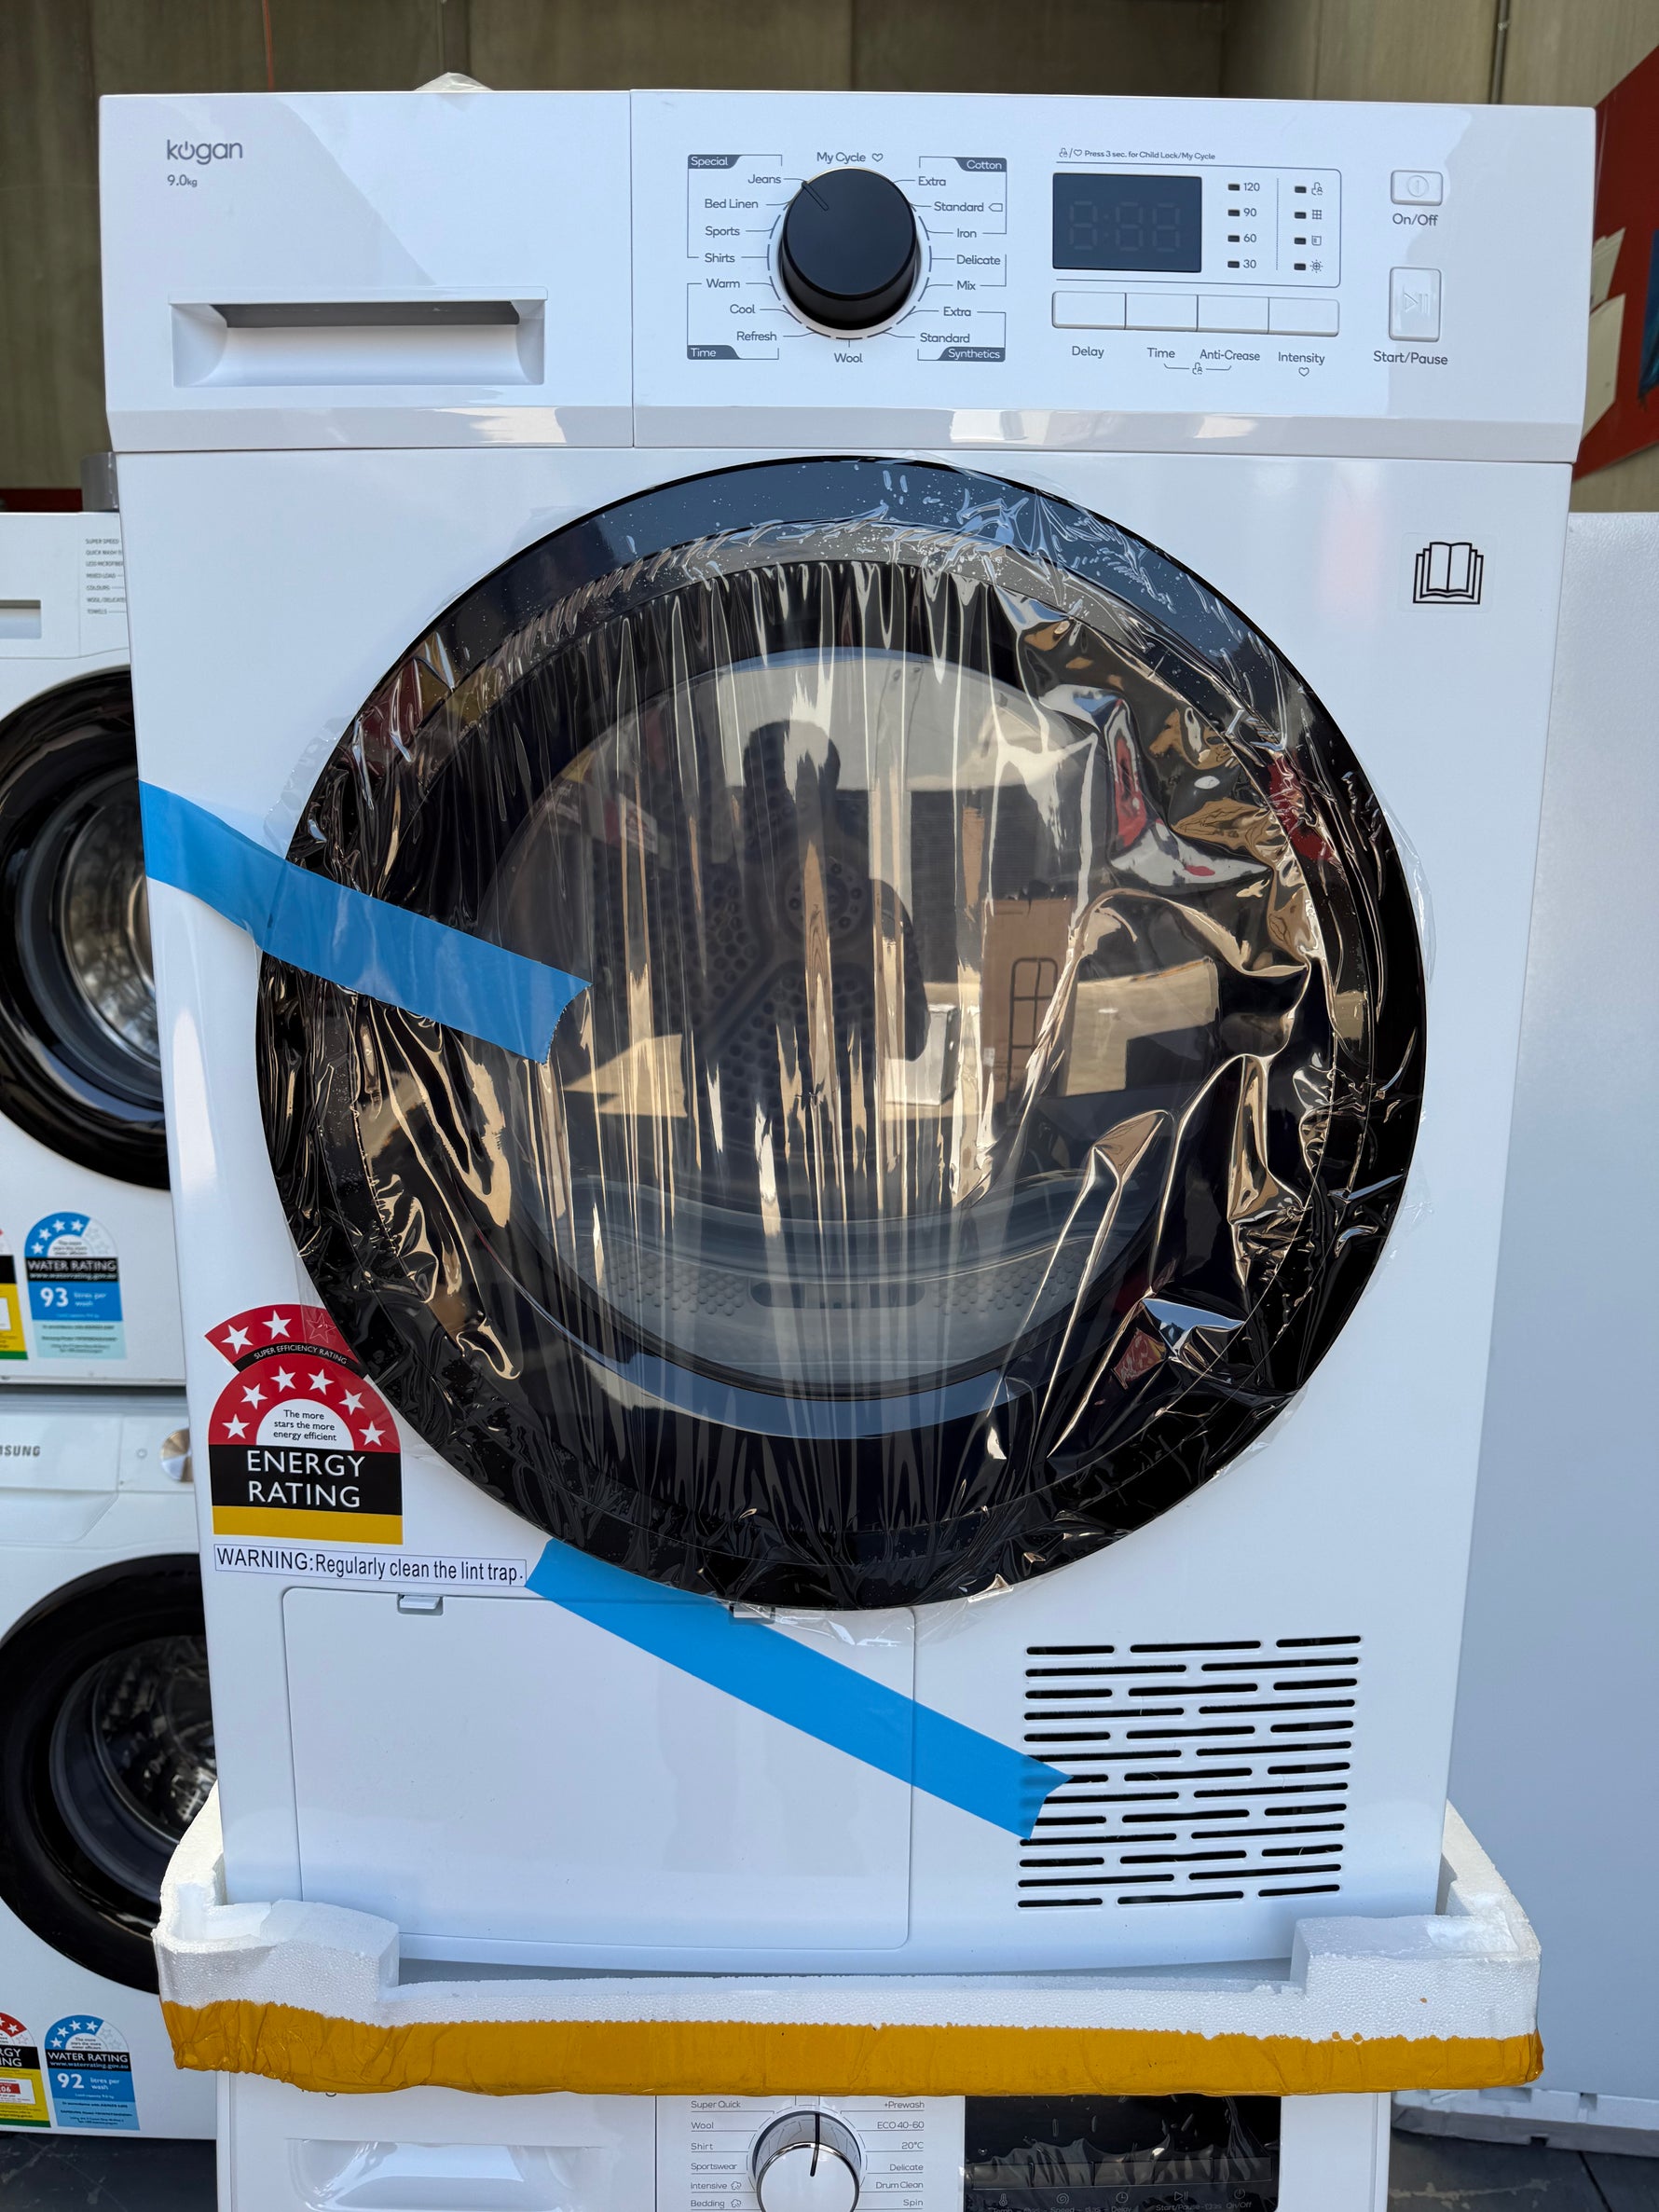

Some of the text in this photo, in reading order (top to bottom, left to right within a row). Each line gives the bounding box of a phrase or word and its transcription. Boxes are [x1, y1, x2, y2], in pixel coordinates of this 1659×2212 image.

[167, 139, 243, 165] kogan
[1128, 150, 1139, 158] for
[1139, 150, 1159, 158] Child
[1160, 151, 1193, 161] Lock/My
[1194, 152, 1215, 161] Cycle
[691, 156, 729, 169] Special
[816, 152, 866, 164] My Cycle
[967, 159, 1003, 171] Cotton
[167, 173, 198, 188] 9.0kg
[748, 174, 782, 185] Jeans
[918, 176, 947, 187] Extra
[1243, 182, 1260, 192] 120
[705, 199, 759, 209] Bed Linen
[934, 201, 984, 213] Standard
[1243, 208, 1257, 217] 90
[1392, 213, 1439, 227] On/Off
[705, 226, 740, 239] Sports
[956, 228, 977, 239] Iron
[1243, 233, 1257, 243] 60
[705, 253, 735, 263] Shirts
[956, 254, 1001, 266] Delicate
[1243, 259, 1256, 269] 30
[706, 279, 741, 289] Warm
[956, 281, 977, 291] Mix
[730, 304, 756, 314] Cool
[943, 306, 972, 317] Extra
[736, 331, 777, 341] Refresh
[920, 333, 970, 344] Standard
[690, 347, 717, 358] Time
[834, 352, 863, 364] Wool
[948, 348, 1001, 361] Synthetics
[1071, 346, 1104, 360] Delay
[1146, 347, 1175, 359] Time
[1200, 349, 1261, 362] Anti-Crease
[1278, 350, 1325, 365] Intensity
[1373, 350, 1448, 365] Start/Pause
[28, 1259, 117, 1272] WATER RATING
[40, 1286, 69, 1308] 93
[254, 1344, 348, 1365] SUPER EFFICIENCY RATING
[283, 1409, 324, 1420] The more
[274, 1420, 336, 1431] stars the more
[273, 1431, 336, 1442] energy efficient
[0, 1445, 41, 1457] SUNG
[246, 1449, 365, 1477] ENERGY
[248, 1480, 362, 1508] RATING
[390, 1559, 430, 1579] clean
[433, 1560, 457, 1579] the
[461, 1561, 484, 1580] lint
[487, 1563, 524, 1585] trap.
[48, 2052, 129, 2064] WATER RATING
[57, 2072, 85, 2089] 92
[691, 2100, 741, 2110] Super Quick
[884, 2100, 925, 2109] +Prewash
[691, 2121, 714, 2130] Wool
[877, 2121, 925, 2130] ECO 40-60
[691, 2142, 713, 2150] Shirt
[901, 2141, 924, 2150] 20°C
[691, 2162, 737, 2172] Sportswear
[889, 2163, 924, 2172] Delicate
[691, 2181, 728, 2190] Intensive
[875, 2180, 924, 2190] Drum Clean
[691, 2198, 725, 2209] Bedding
[902, 2198, 924, 2208] Spin
